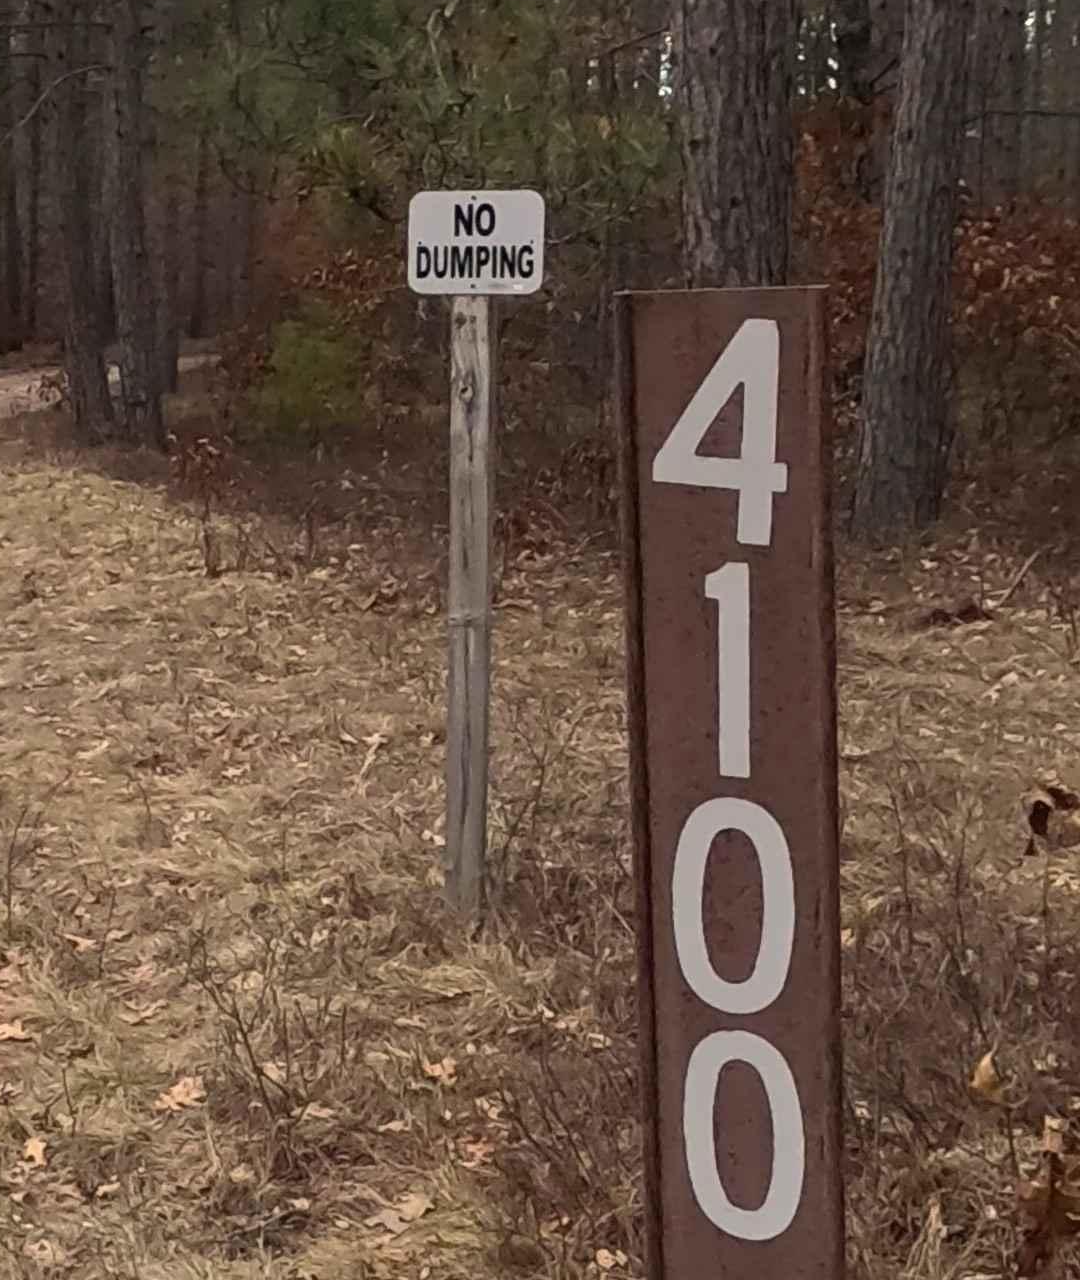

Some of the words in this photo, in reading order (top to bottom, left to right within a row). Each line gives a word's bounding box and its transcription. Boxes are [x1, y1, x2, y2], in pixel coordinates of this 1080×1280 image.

[454, 203, 496, 237] NO
[416, 245, 534, 279] DUMPING
[652, 318, 804, 1241] 4100
